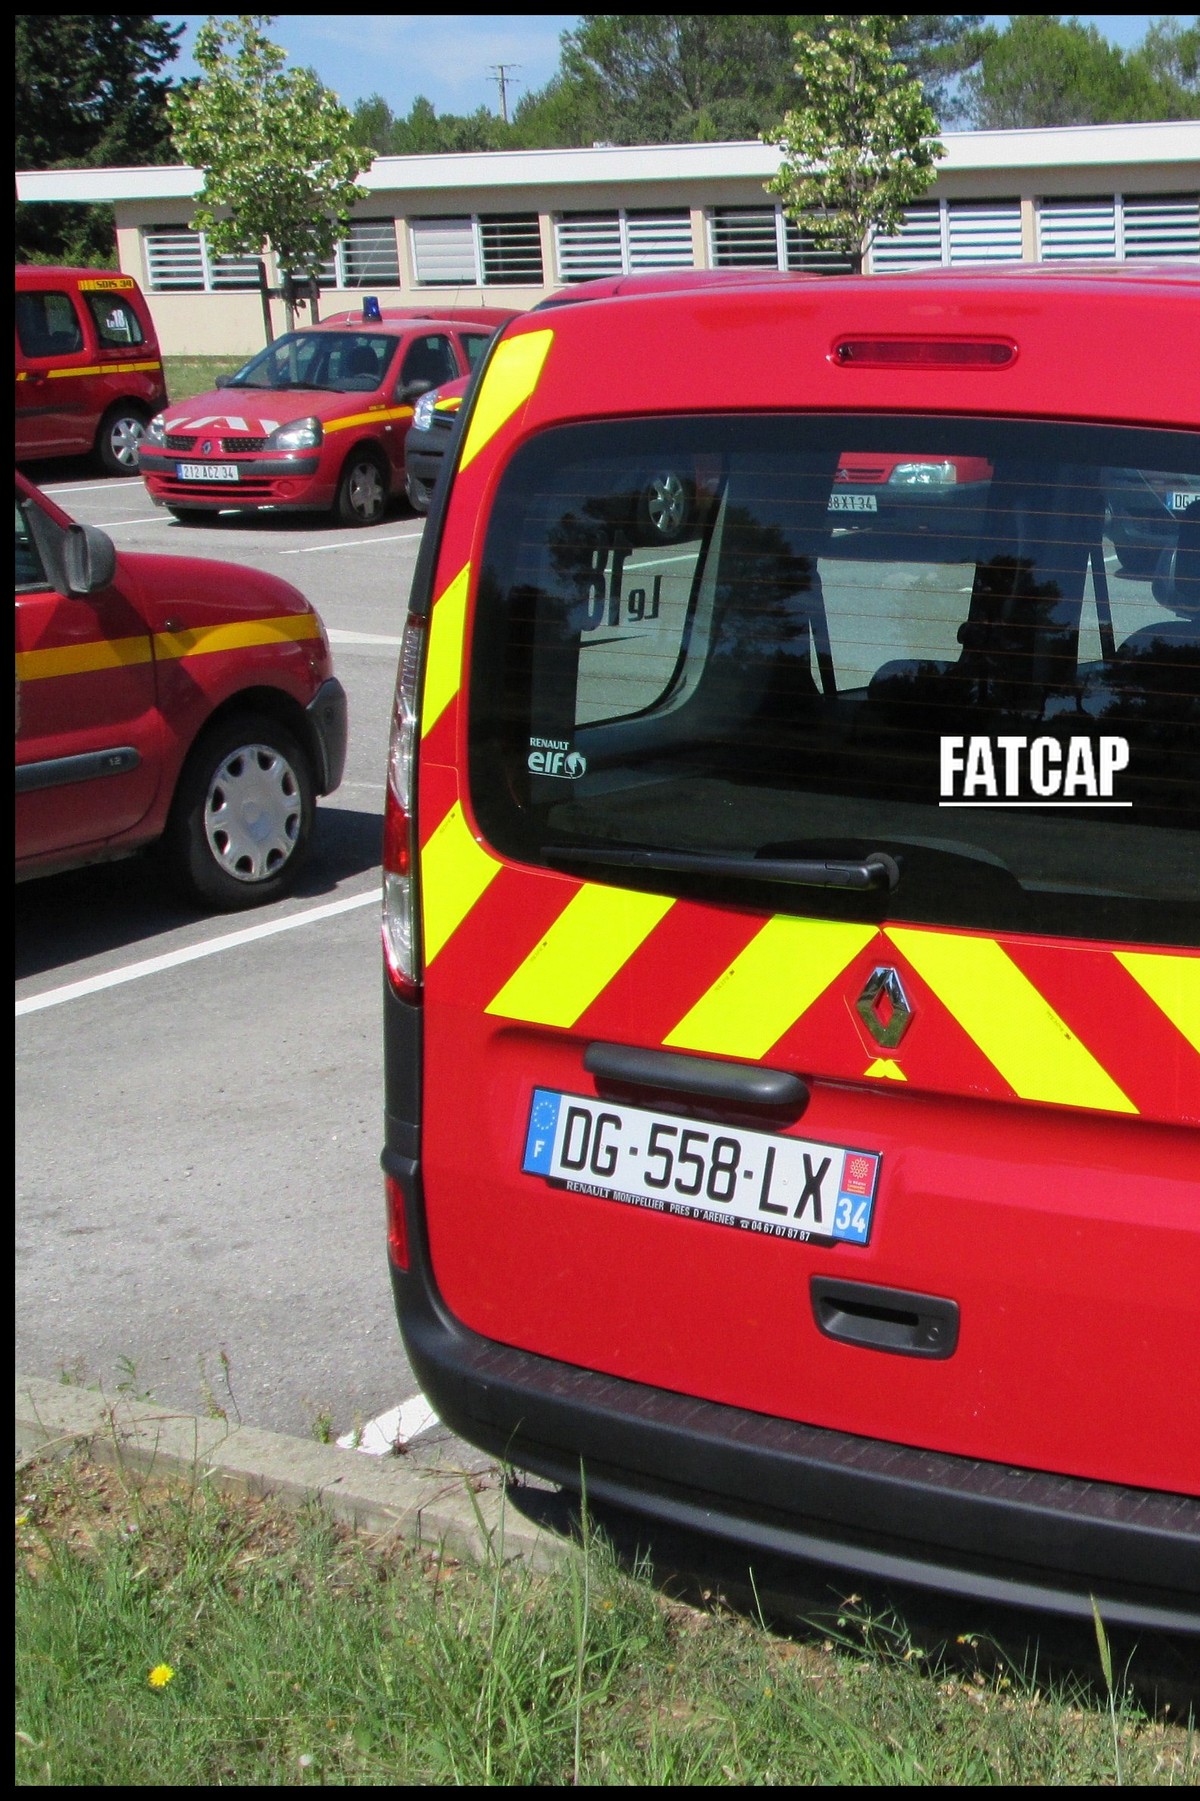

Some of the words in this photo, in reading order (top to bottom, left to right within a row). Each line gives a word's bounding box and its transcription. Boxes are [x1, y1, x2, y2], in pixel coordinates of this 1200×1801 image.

[112, 310, 125, 327] 18
[184, 466, 199, 478] 212
[222, 467, 233, 478] 34
[530, 737, 569, 750] RENAULT
[528, 751, 564, 773] elf
[534, 1140, 545, 1158] F
[560, 1106, 832, 1223] DG-558-LX
[566, 1180, 611, 1199] RENAULT
[613, 1191, 665, 1210] MONTPELLIER
[669, 1203, 690, 1217] PRES
[751, 1222, 762, 1232] 04
[763, 1224, 774, 1234] 67
[775, 1226, 786, 1236] 07
[787, 1228, 798, 1239] 87
[799, 1231, 811, 1242] 87
[836, 1198, 867, 1234] 34
